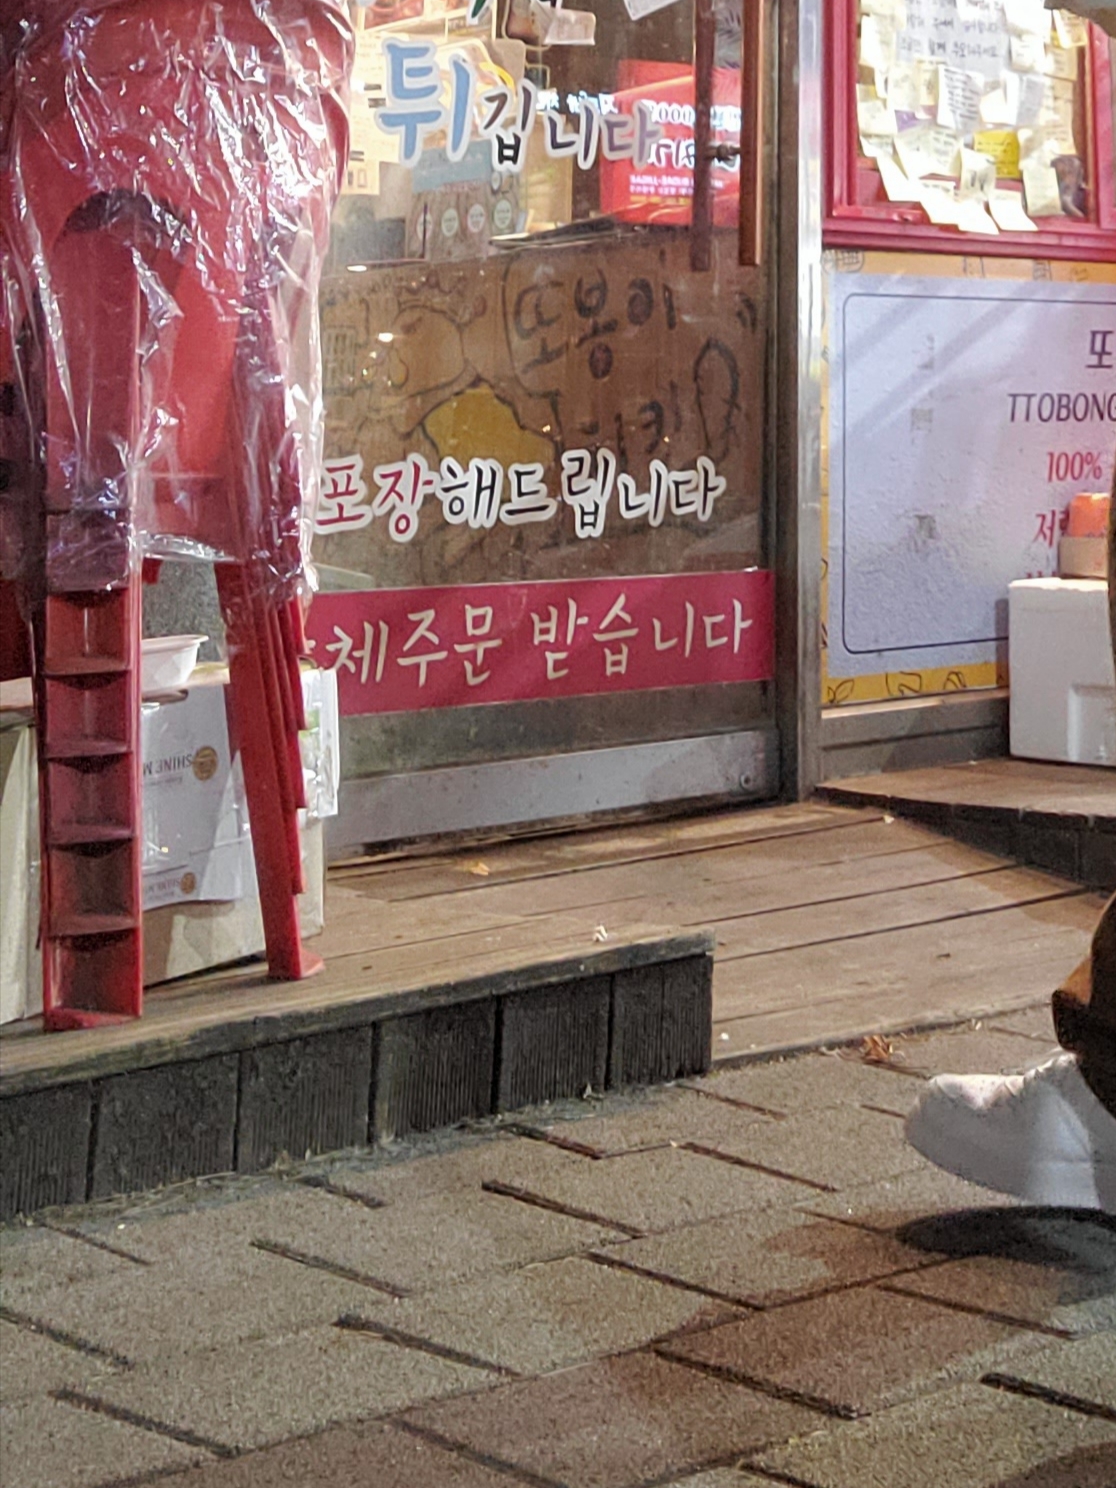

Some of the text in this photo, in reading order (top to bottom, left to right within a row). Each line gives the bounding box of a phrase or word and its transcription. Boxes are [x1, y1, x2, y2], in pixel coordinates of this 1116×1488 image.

[378, 42, 662, 166] 튀깁니다
[1046, 451, 1103, 483] 100%
[302, 593, 753, 688] 체주문 받습니다
